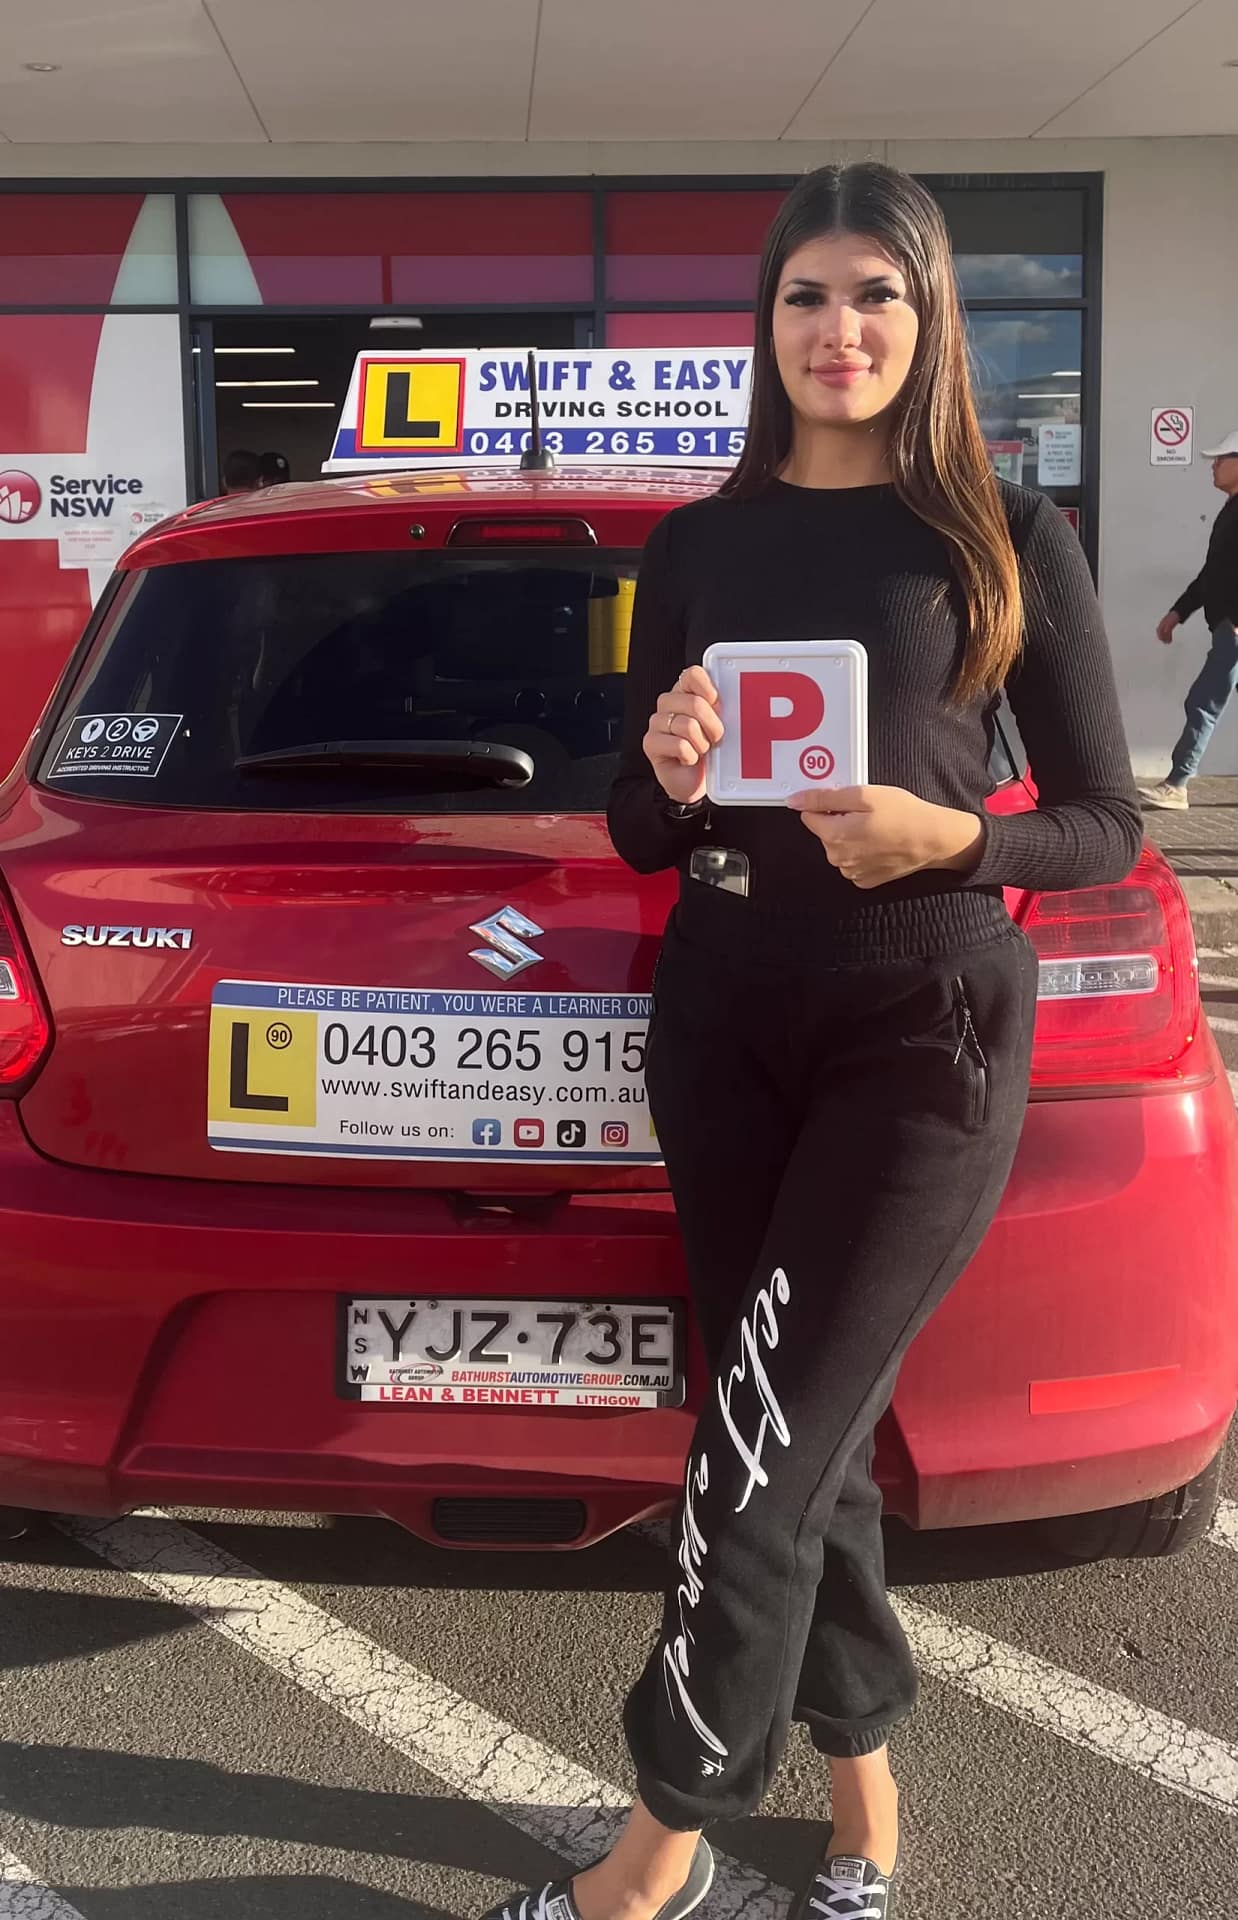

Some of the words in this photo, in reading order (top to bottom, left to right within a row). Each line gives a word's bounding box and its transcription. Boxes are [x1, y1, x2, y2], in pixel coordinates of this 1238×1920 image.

[479, 361, 592, 391] SWIFT
[608, 360, 636, 390] &
[654, 359, 747, 390] EASY
[383, 372, 441, 438] L
[617, 400, 729, 417] SCHOOL
[585, 431, 655, 454] 265
[676, 431, 745, 454] 915
[50, 474, 143, 495] Service
[51, 498, 114, 518] NSW
[740, 672, 825, 779] P
[66, 746, 99, 759] KEYS
[100, 746, 110, 758] 2
[111, 746, 155, 759] DRIVE
[806, 756, 827, 770] 90
[61, 925, 193, 949] SUZUKI
[278, 988, 335, 1007] PLEASE
[341, 991, 361, 1008] BE
[366, 992, 435, 1012] PATIENT,
[442, 995, 474, 1012] YOU
[481, 996, 526, 1013] WERE
[532, 997, 543, 1013] A
[549, 998, 621, 1015] LEARNER
[271, 1029, 288, 1043] 90
[323, 1022, 436, 1068] 0403
[456, 1028, 541, 1071] 265
[562, 1030, 646, 1072] 915
[229, 1022, 289, 1112] L
[321, 1078, 645, 1106] www.swiftandeasy.com.au
[340, 1119, 394, 1136] Follow
[401, 1126, 421, 1137] us
[428, 1126, 454, 1138] on:
[451, 1370, 669, 1387] BATHURSTAUTOMOTIVEGROUP.COM.AU
[380, 1386, 432, 1401] LEAN
[441, 1387, 454, 1401] &
[463, 1387, 559, 1404] BENNETT
[576, 1395, 640, 1406] LITHGOW
